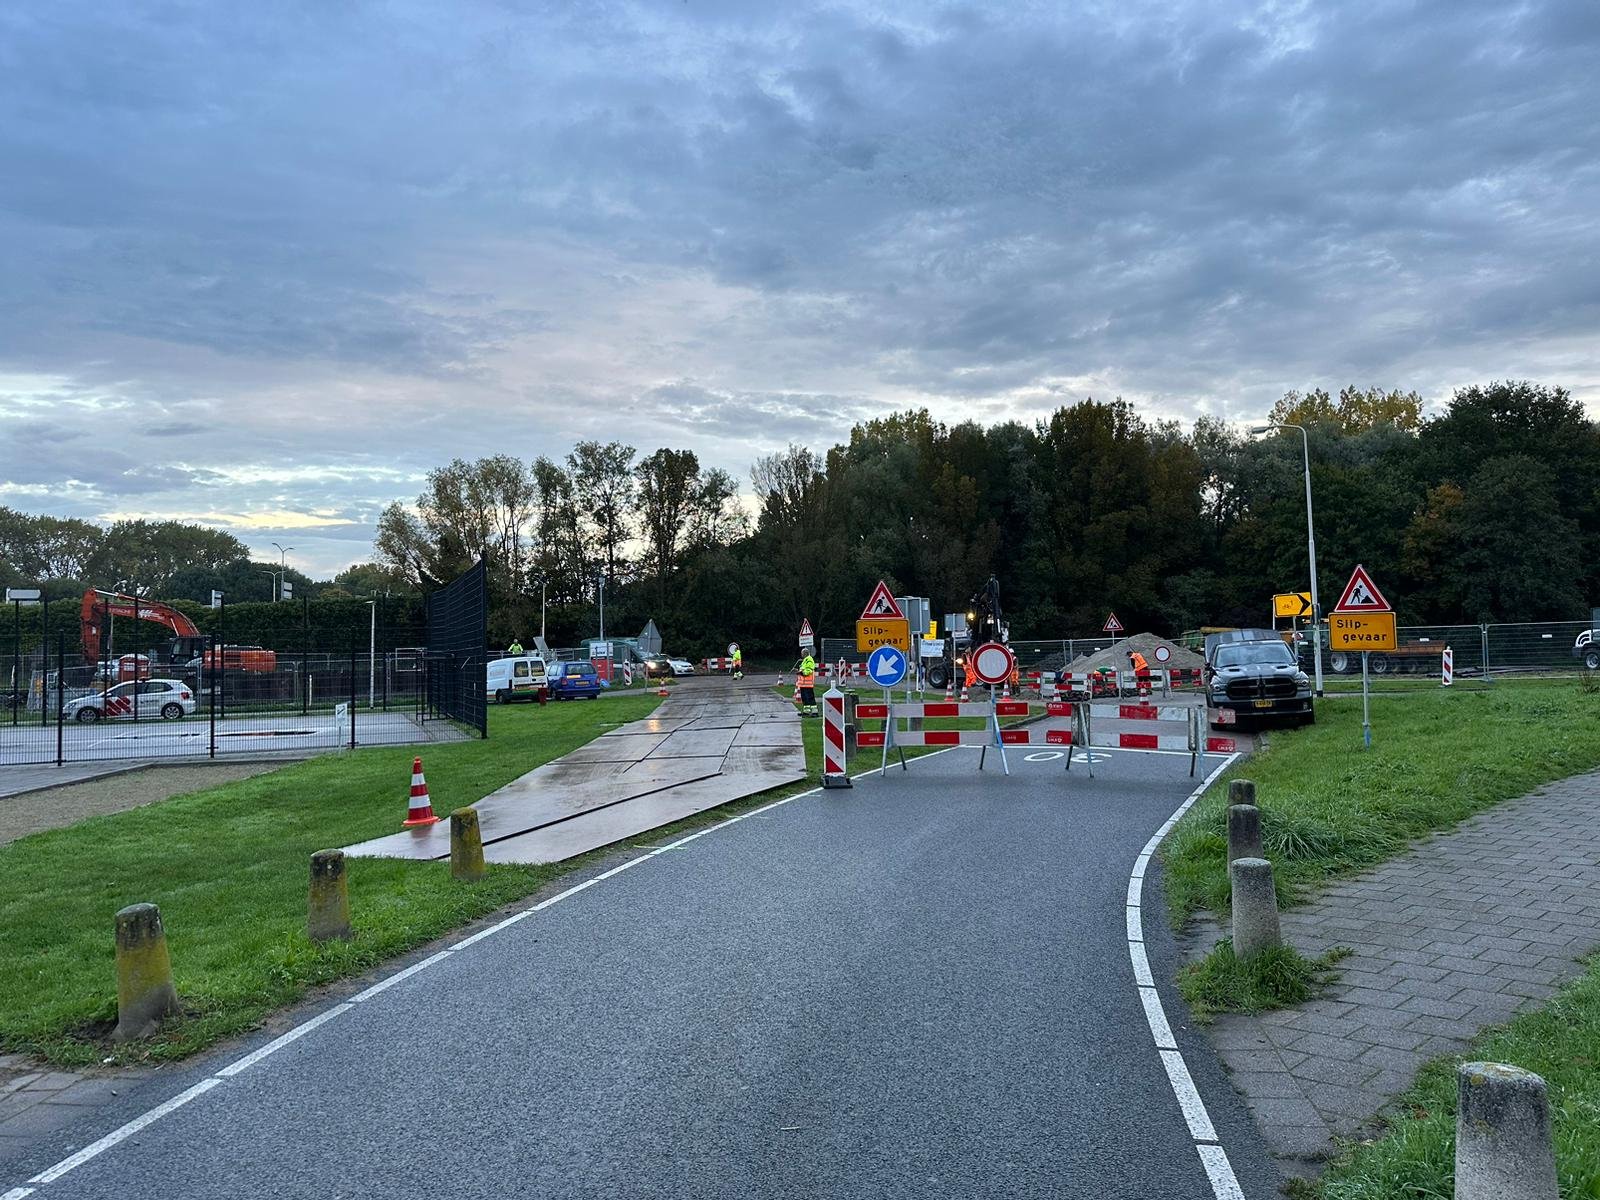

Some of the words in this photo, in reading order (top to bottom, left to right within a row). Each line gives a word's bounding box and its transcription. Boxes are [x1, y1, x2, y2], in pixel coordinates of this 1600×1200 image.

[1336, 619, 1368, 629] Slip-
[863, 627, 888, 635] Slip-
[868, 638, 903, 647] gevaar
[1342, 633, 1387, 643] gevaar
